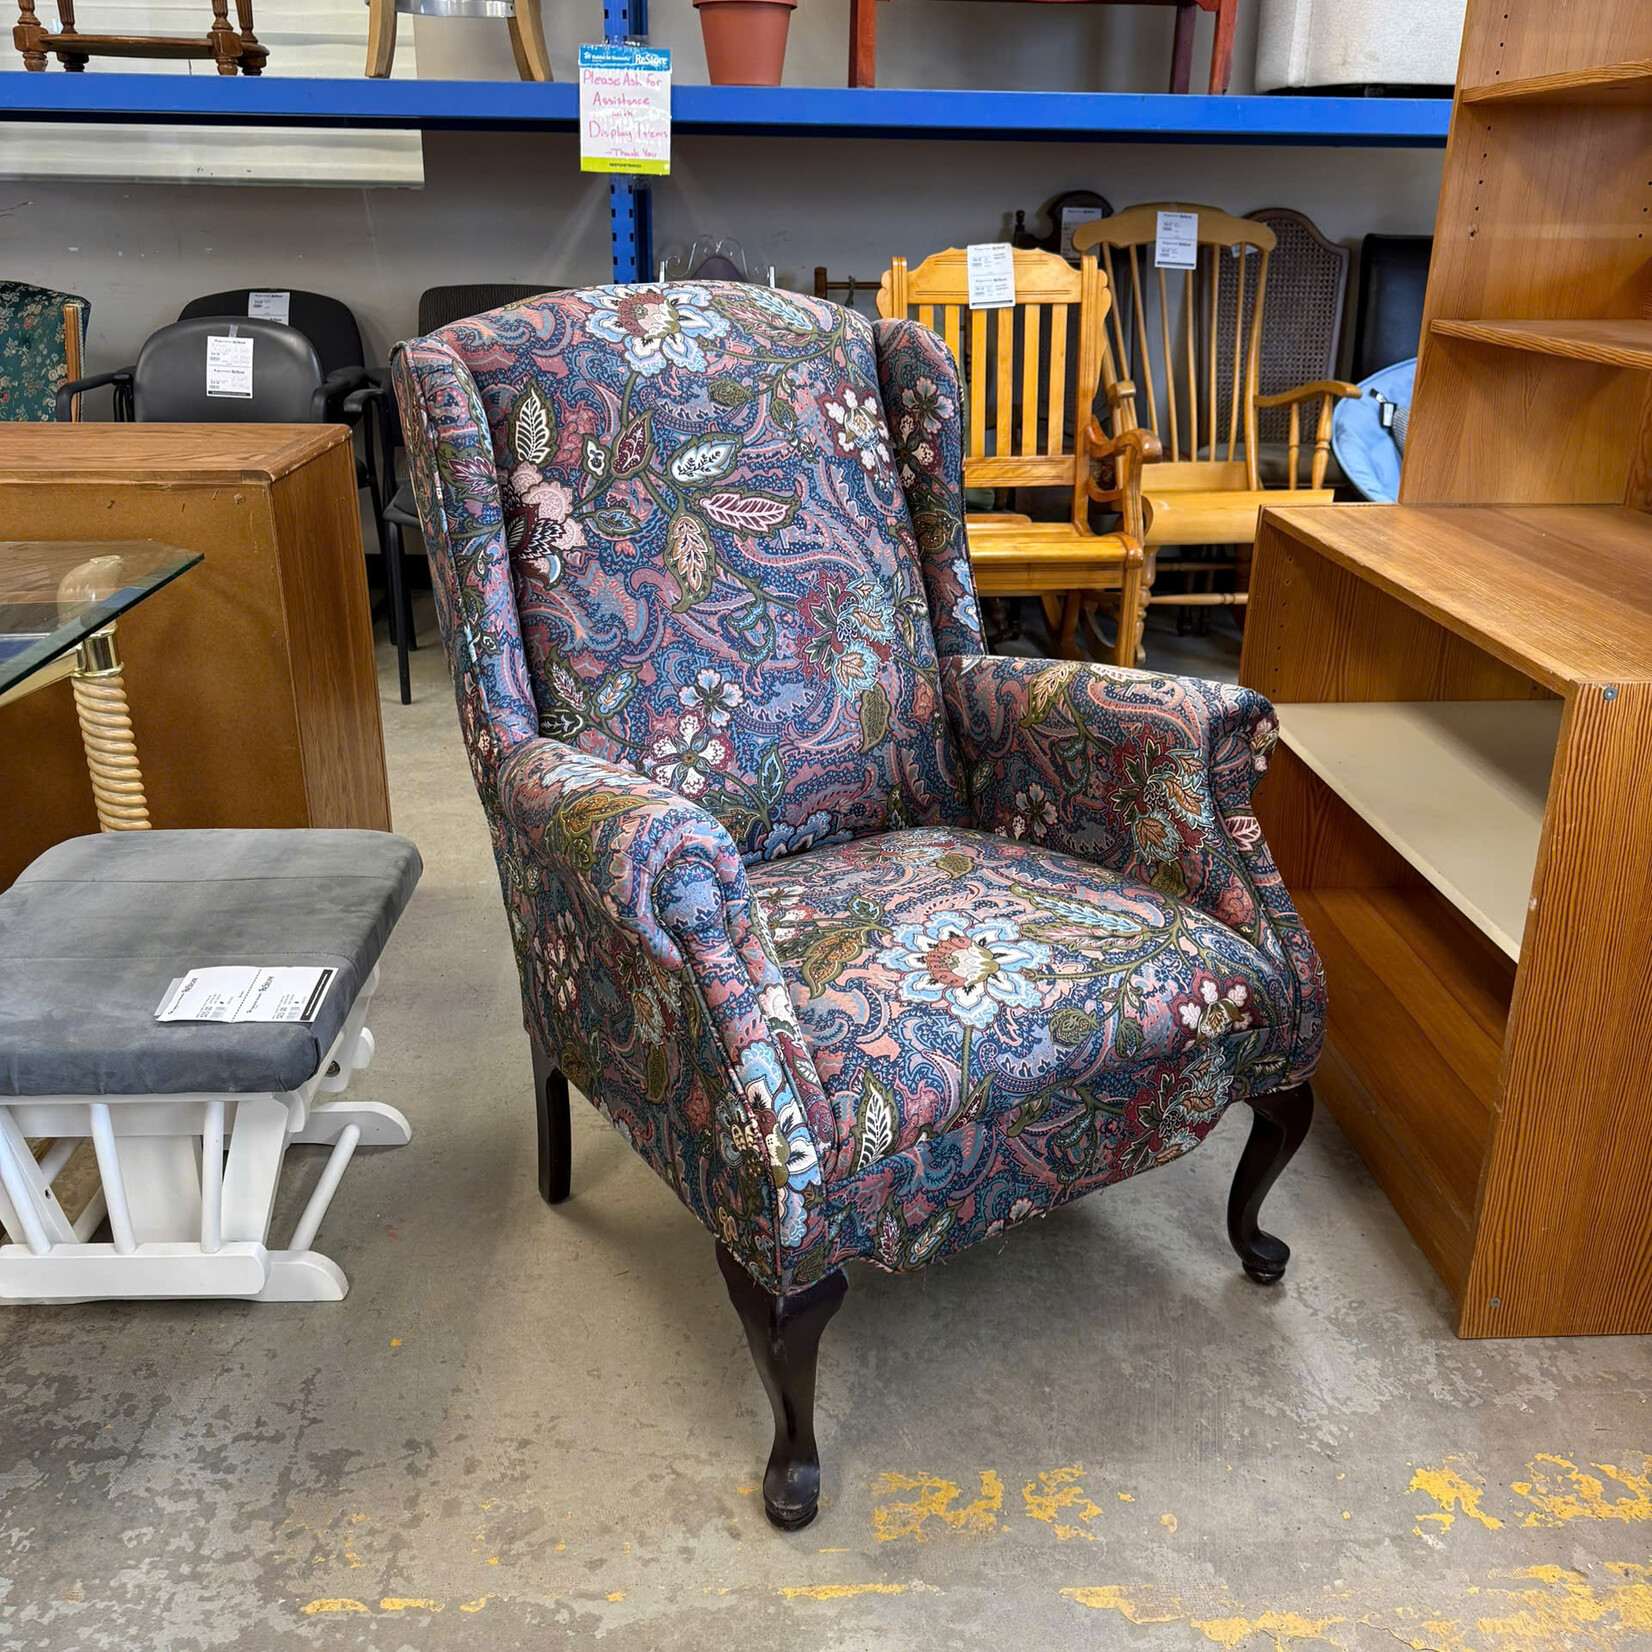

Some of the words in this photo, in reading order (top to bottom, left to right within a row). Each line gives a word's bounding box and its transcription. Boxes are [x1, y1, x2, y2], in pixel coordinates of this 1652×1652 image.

[634, 53, 669, 66] ReStore
[583, 69, 621, 86] Please
[622, 72, 641, 87] Ask
[646, 73, 662, 87] For
[592, 91, 650, 106] Assistance
[612, 110, 633, 118] with
[588, 120, 632, 142] Display
[637, 122, 669, 139] Items
[642, 147, 658, 158] You
